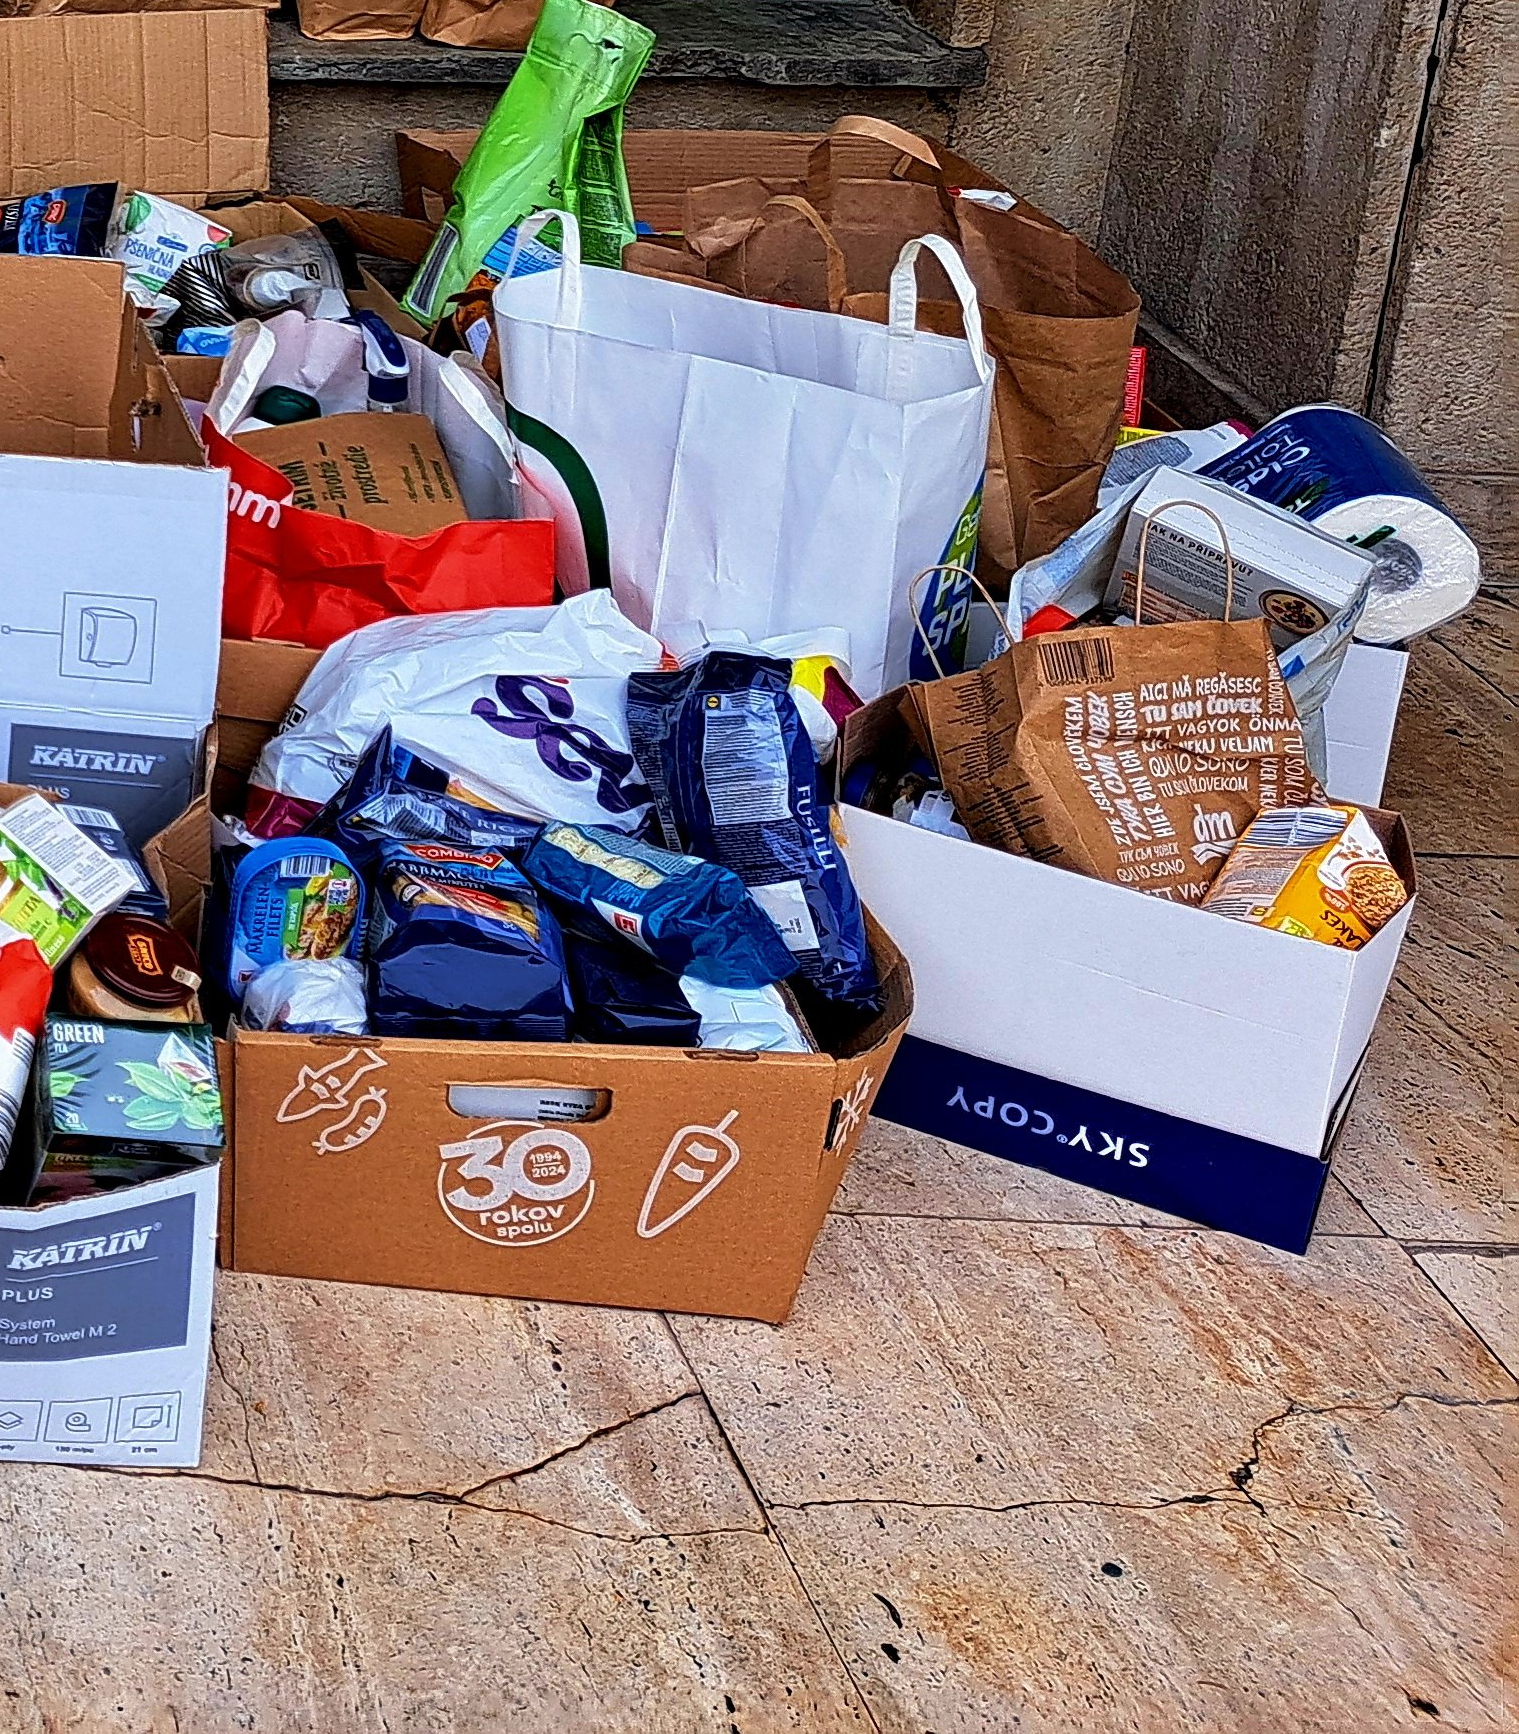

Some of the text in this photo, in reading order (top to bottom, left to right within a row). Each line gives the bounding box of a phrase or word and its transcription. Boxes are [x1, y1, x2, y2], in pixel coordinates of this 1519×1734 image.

[124, 237, 175, 267] PŠENIČNÁ
[348, 445, 389, 505] prostredie
[1170, 531, 1185, 547] NA
[1139, 671, 1262, 702] AICI MĂ REGĂSESC
[1139, 705, 1167, 724] TU
[1206, 695, 1263, 716] ČOVEK
[1177, 718, 1241, 737] VAGYOK
[1219, 736, 1274, 752] VELJAM
[1064, 696, 1133, 847] ZDE JSEM ČLOVĚKEM
[1113, 691, 1176, 839] HIER BIN ICH MENSCH
[1194, 756, 1251, 772] SONO
[1189, 776, 1249, 792] ČLOVEKOM
[796, 784, 837, 872] FUSILLI
[1192, 803, 1237, 843] dm
[1152, 858, 1185, 876] SONO
[266, 896, 283, 939] FILETS
[53, 1023, 105, 1044] GREEN
[946, 1085, 1055, 1135] COPY
[530, 1151, 562, 1164] 1994
[439, 1128, 591, 1211] 30
[532, 1167, 565, 1178] 2024
[480, 1205, 565, 1225] rokov
[497, 1221, 553, 1239] spolu
[1, 1287, 54, 1303] PLUS
[42, 1330, 85, 1344] Towel
[88, 1327, 103, 1338] M
[106, 1324, 117, 1336] 2
